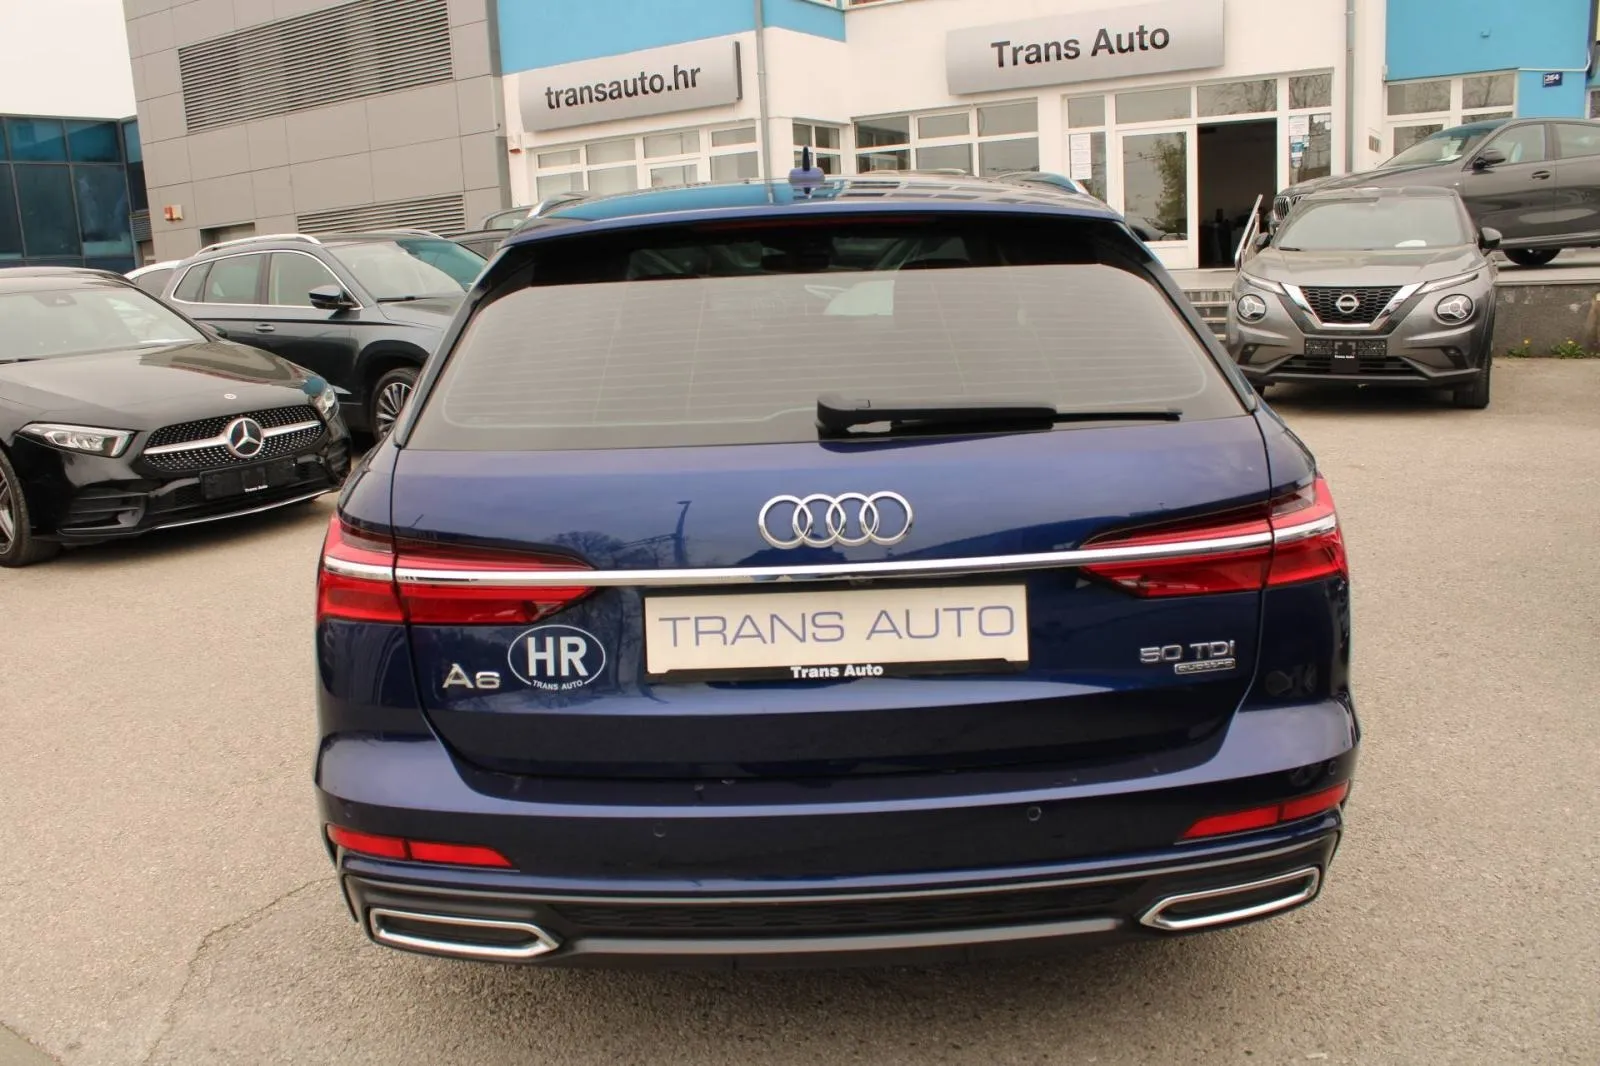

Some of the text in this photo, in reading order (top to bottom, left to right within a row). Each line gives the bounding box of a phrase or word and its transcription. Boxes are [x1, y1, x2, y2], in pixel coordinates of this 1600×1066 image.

[990, 25, 1170, 68] Trans Auto
[545, 65, 701, 109] transauto.hr
[658, 605, 1014, 647] TRANS AUTO
[527, 636, 589, 677] HR
[1140, 640, 1235, 662] 50 TDI
[442, 663, 500, 688] A6
[532, 680, 584, 691] TRANS AUTO
[790, 664, 884, 679] Trans Auto
